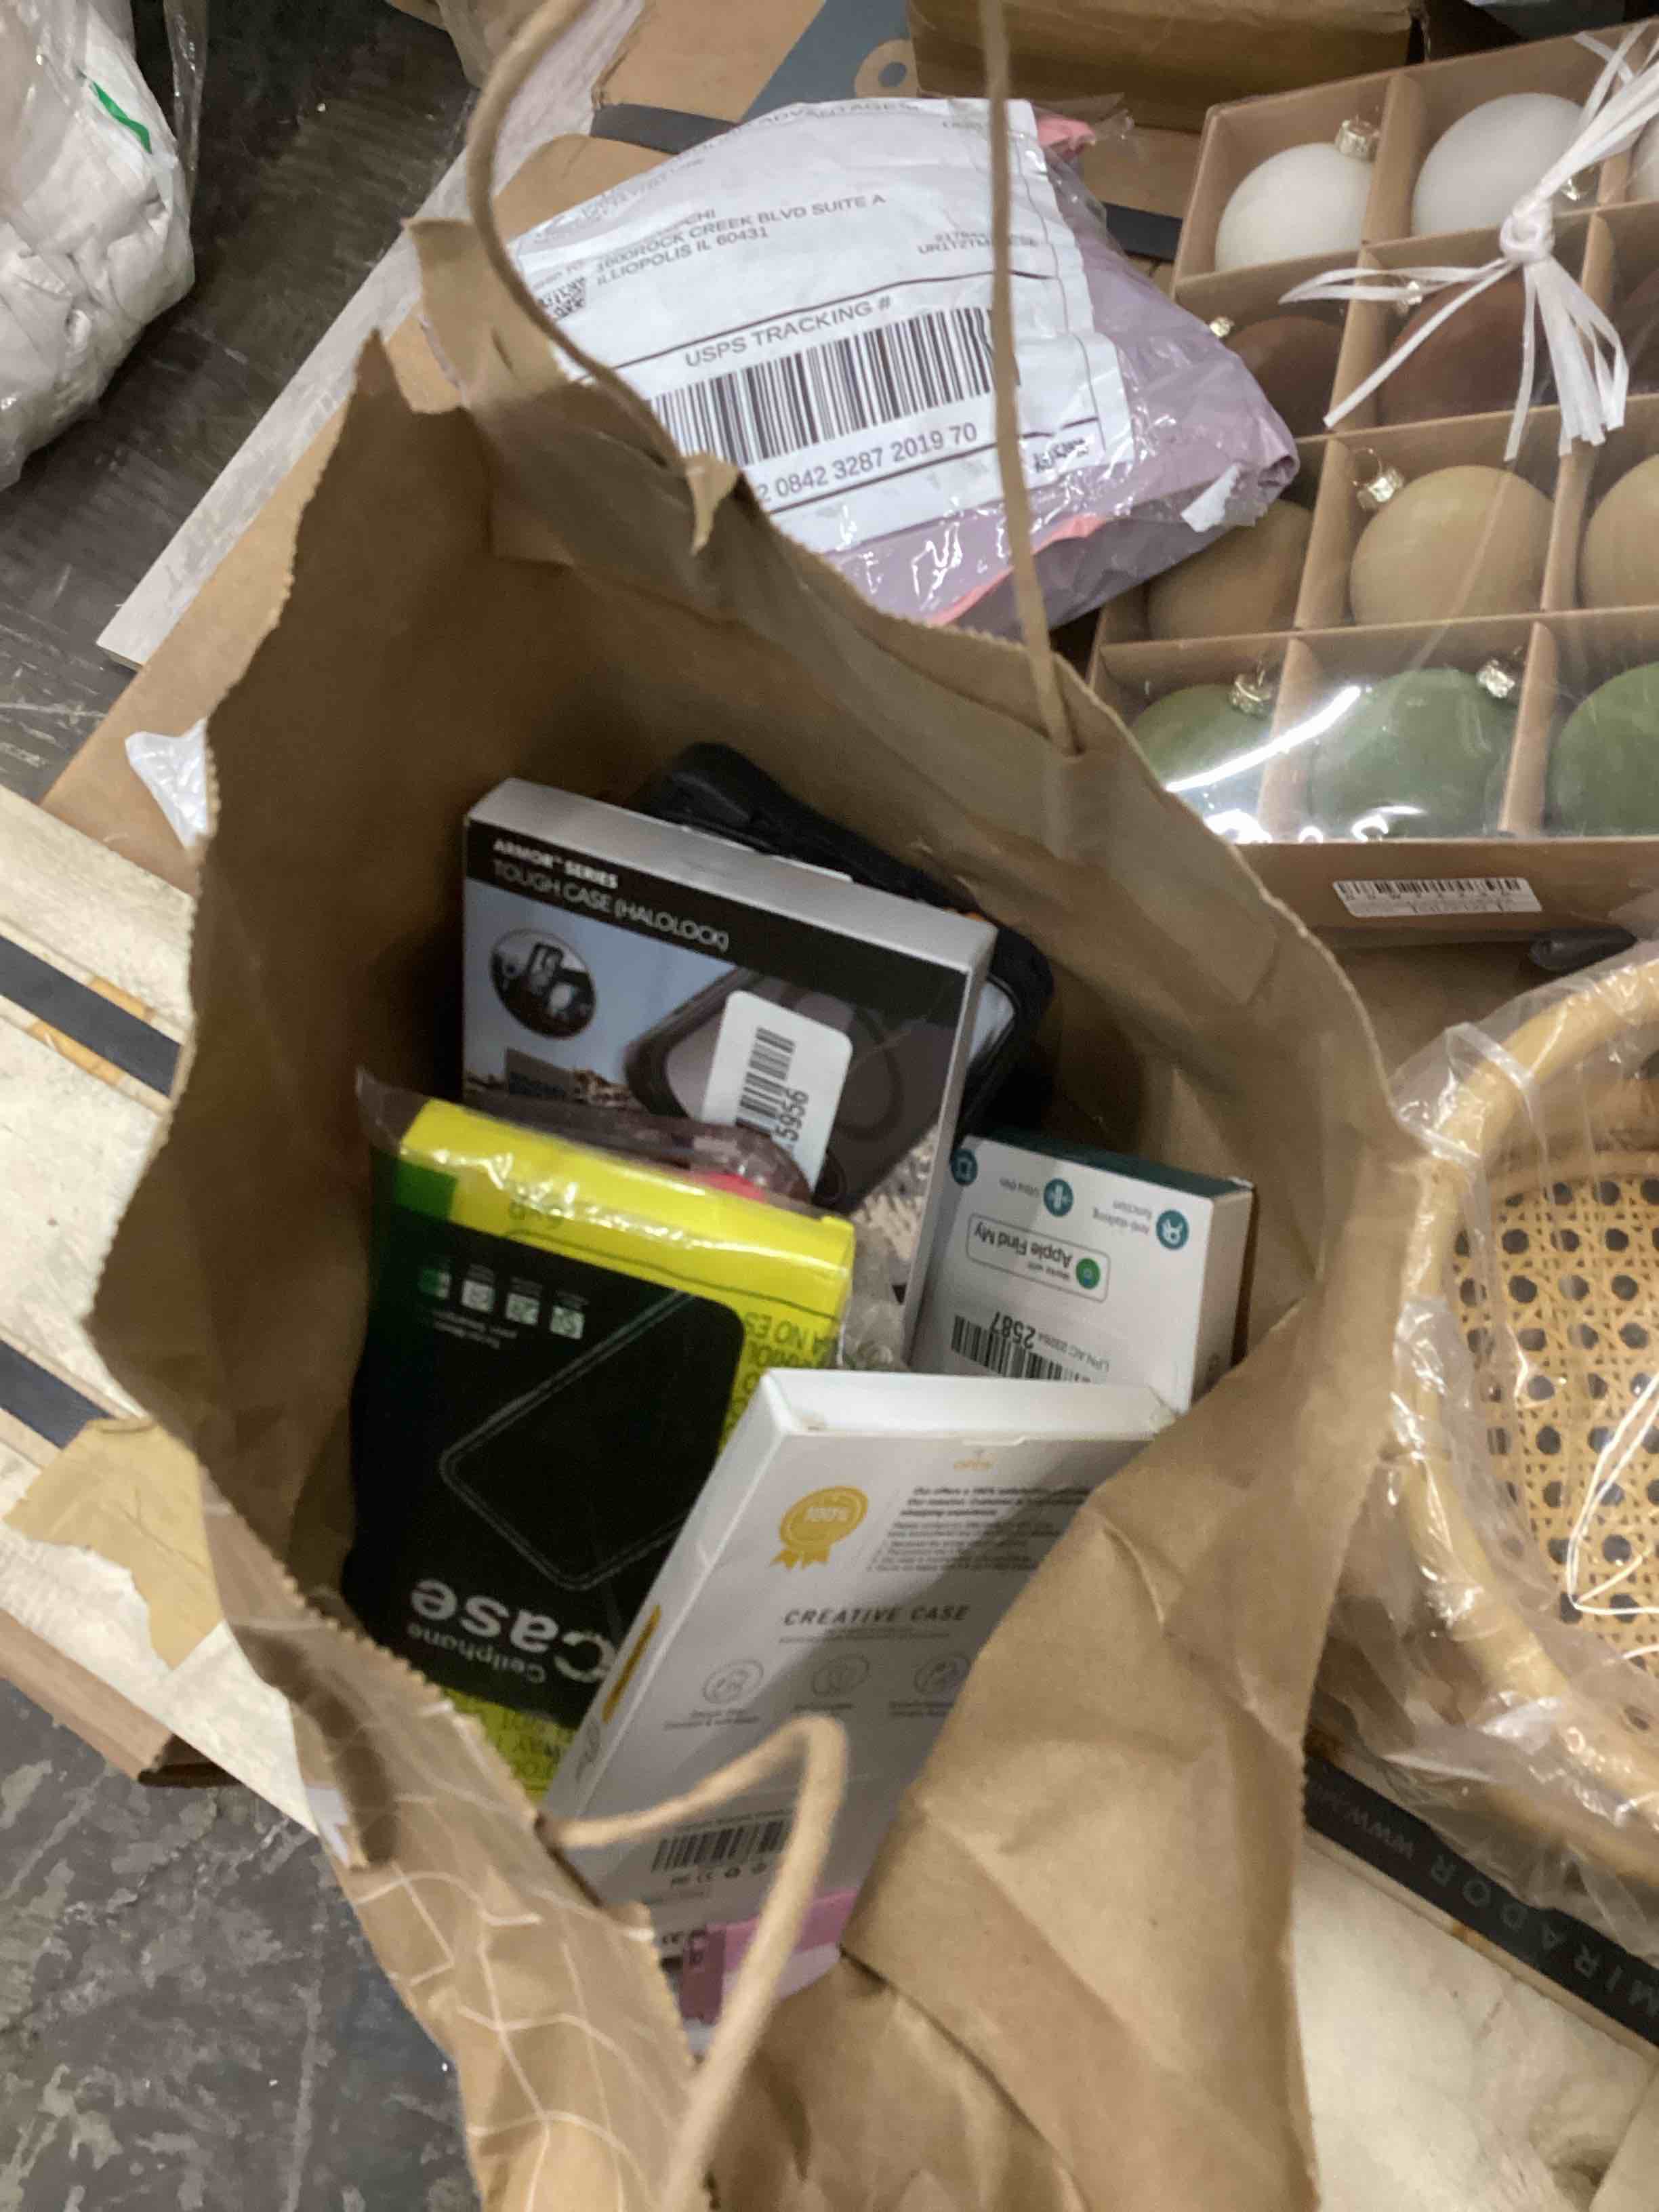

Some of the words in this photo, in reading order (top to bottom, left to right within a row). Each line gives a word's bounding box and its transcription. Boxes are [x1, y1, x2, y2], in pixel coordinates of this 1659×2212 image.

[688, 215, 753, 239] CREEK
[757, 206, 807, 224] BLVD
[812, 196, 867, 216] SUITE
[872, 194, 886, 204] A
[696, 240, 711, 253] IL
[716, 226, 769, 247] 60431
[684, 336, 747, 368] USPS
[750, 300, 873, 346] TRACKING
[877, 295, 892, 311] #
[775, 465, 829, 497] 0842
[832, 447, 884, 481] 3287
[890, 430, 945, 464] 2019
[947, 422, 978, 446] 70
[565, 859, 618, 889] SERIES
[493, 858, 561, 897] TOUGH
[562, 881, 612, 912] CASE
[614, 898, 729, 952] (HALOLOCK)
[774, 1088, 808, 1141] 5956
[973, 1221, 996, 1245] My
[998, 1231, 1027, 1255] Find
[1030, 1242, 1073, 1268] Apple
[990, 1311, 1036, 1349] 2587
[411, 1579, 616, 1683] Case
[783, 1605, 902, 1626] CREATIVE
[911, 1605, 970, 1620] CASE
